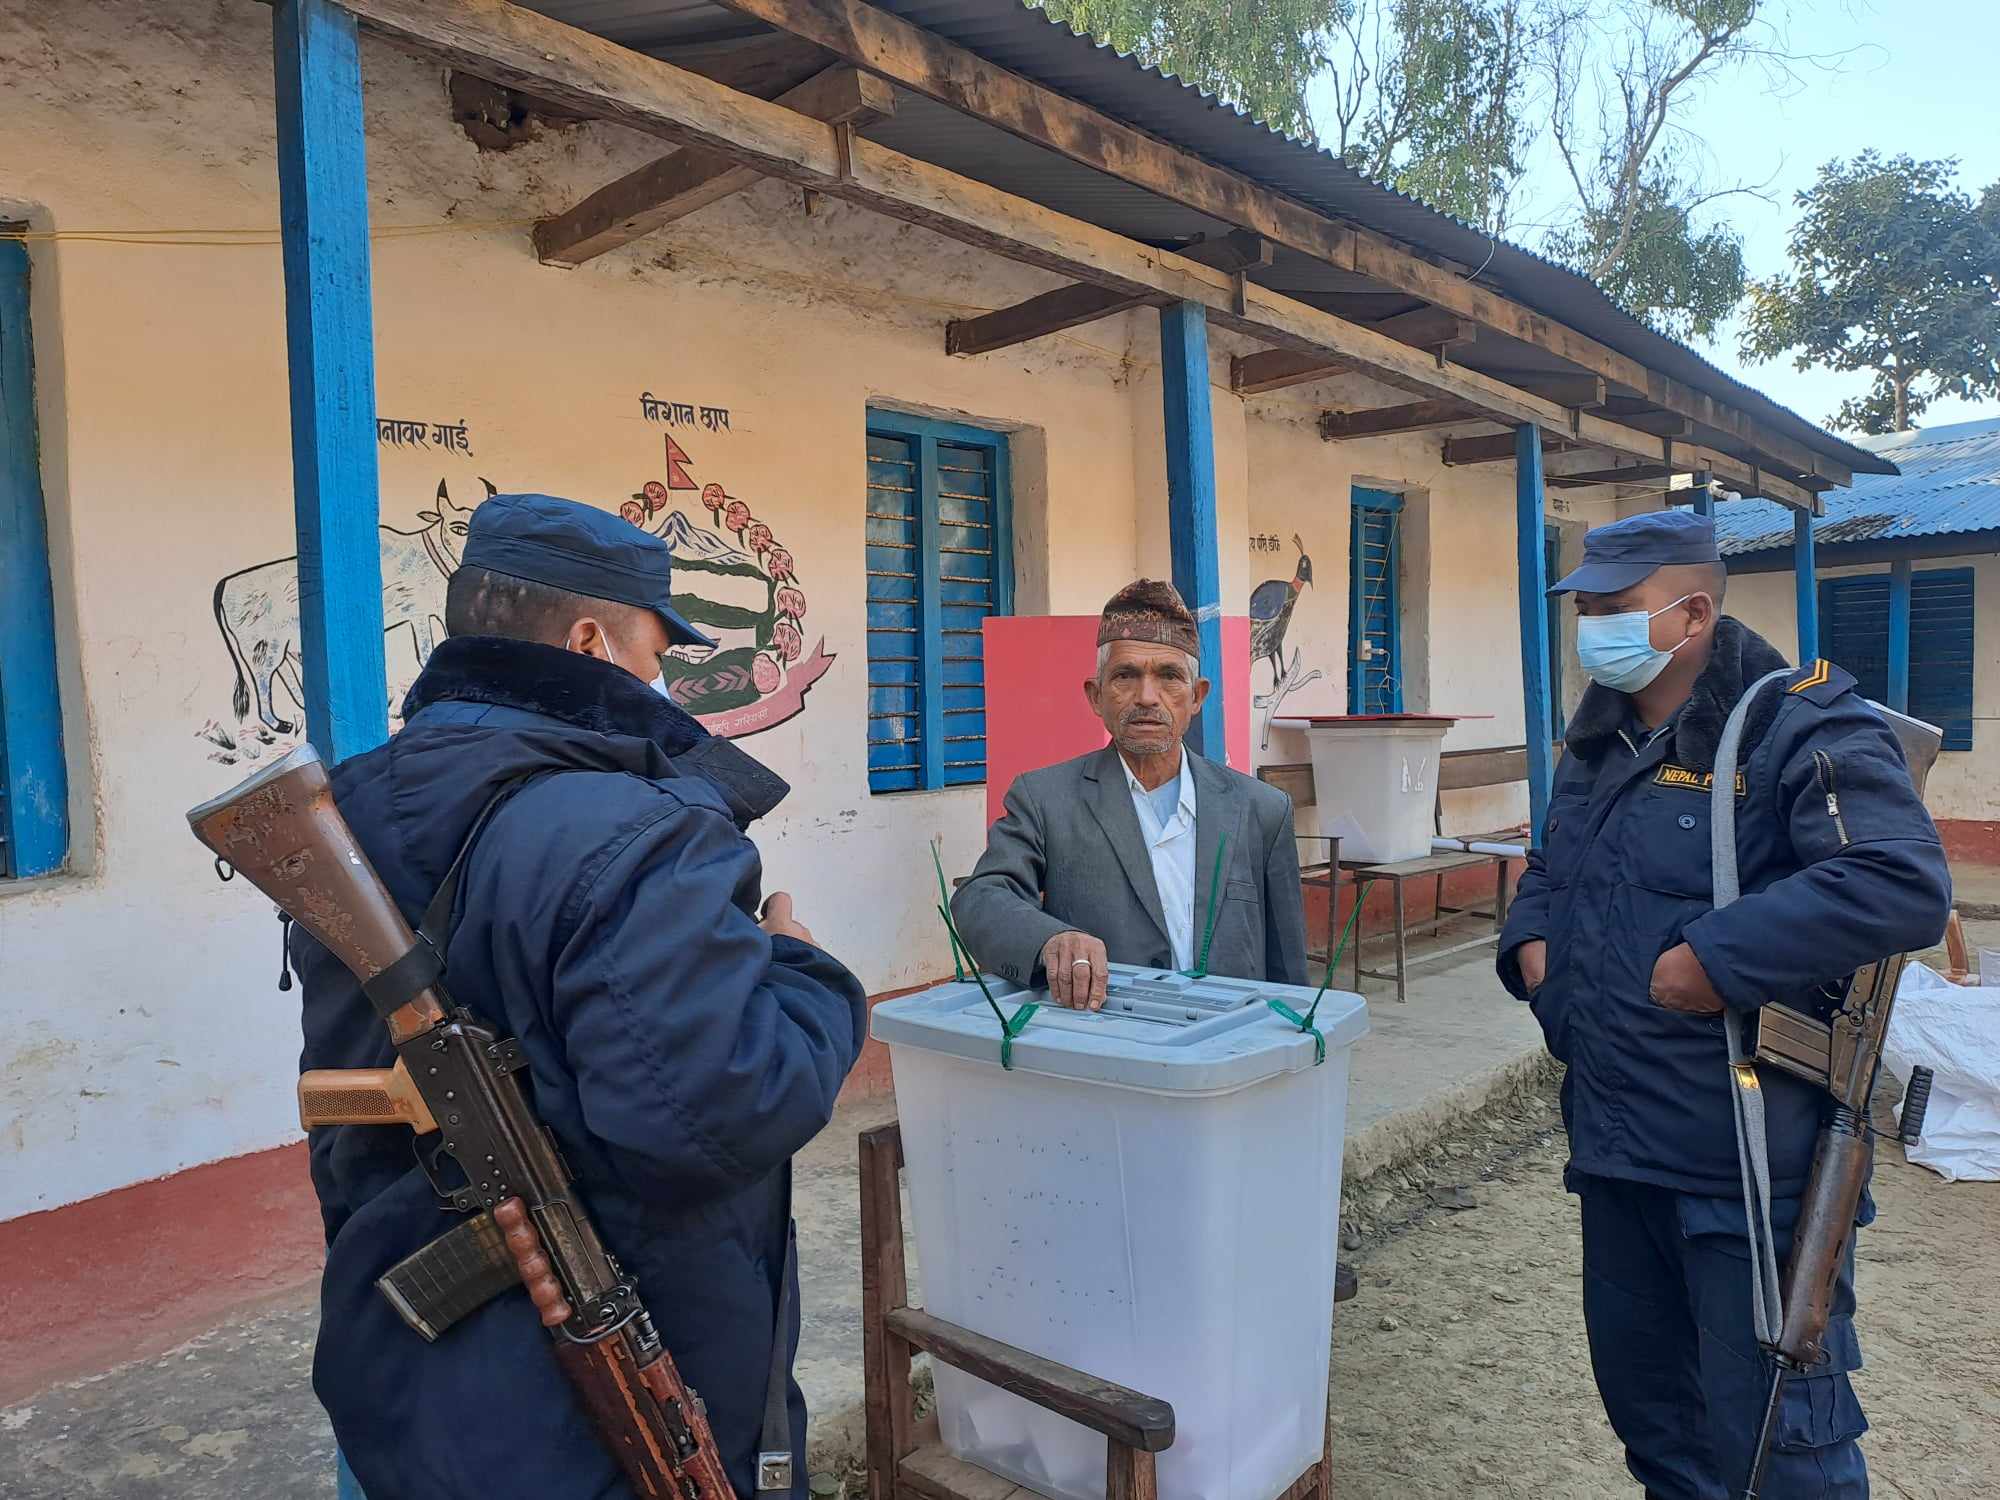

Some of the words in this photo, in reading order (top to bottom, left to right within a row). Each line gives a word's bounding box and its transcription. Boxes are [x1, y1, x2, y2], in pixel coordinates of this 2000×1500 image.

[639, 392, 696, 428] निशान
[376, 418, 430, 450] नावर
[432, 418, 473, 457] गाई
[1661, 768, 1699, 784] NEPAL
